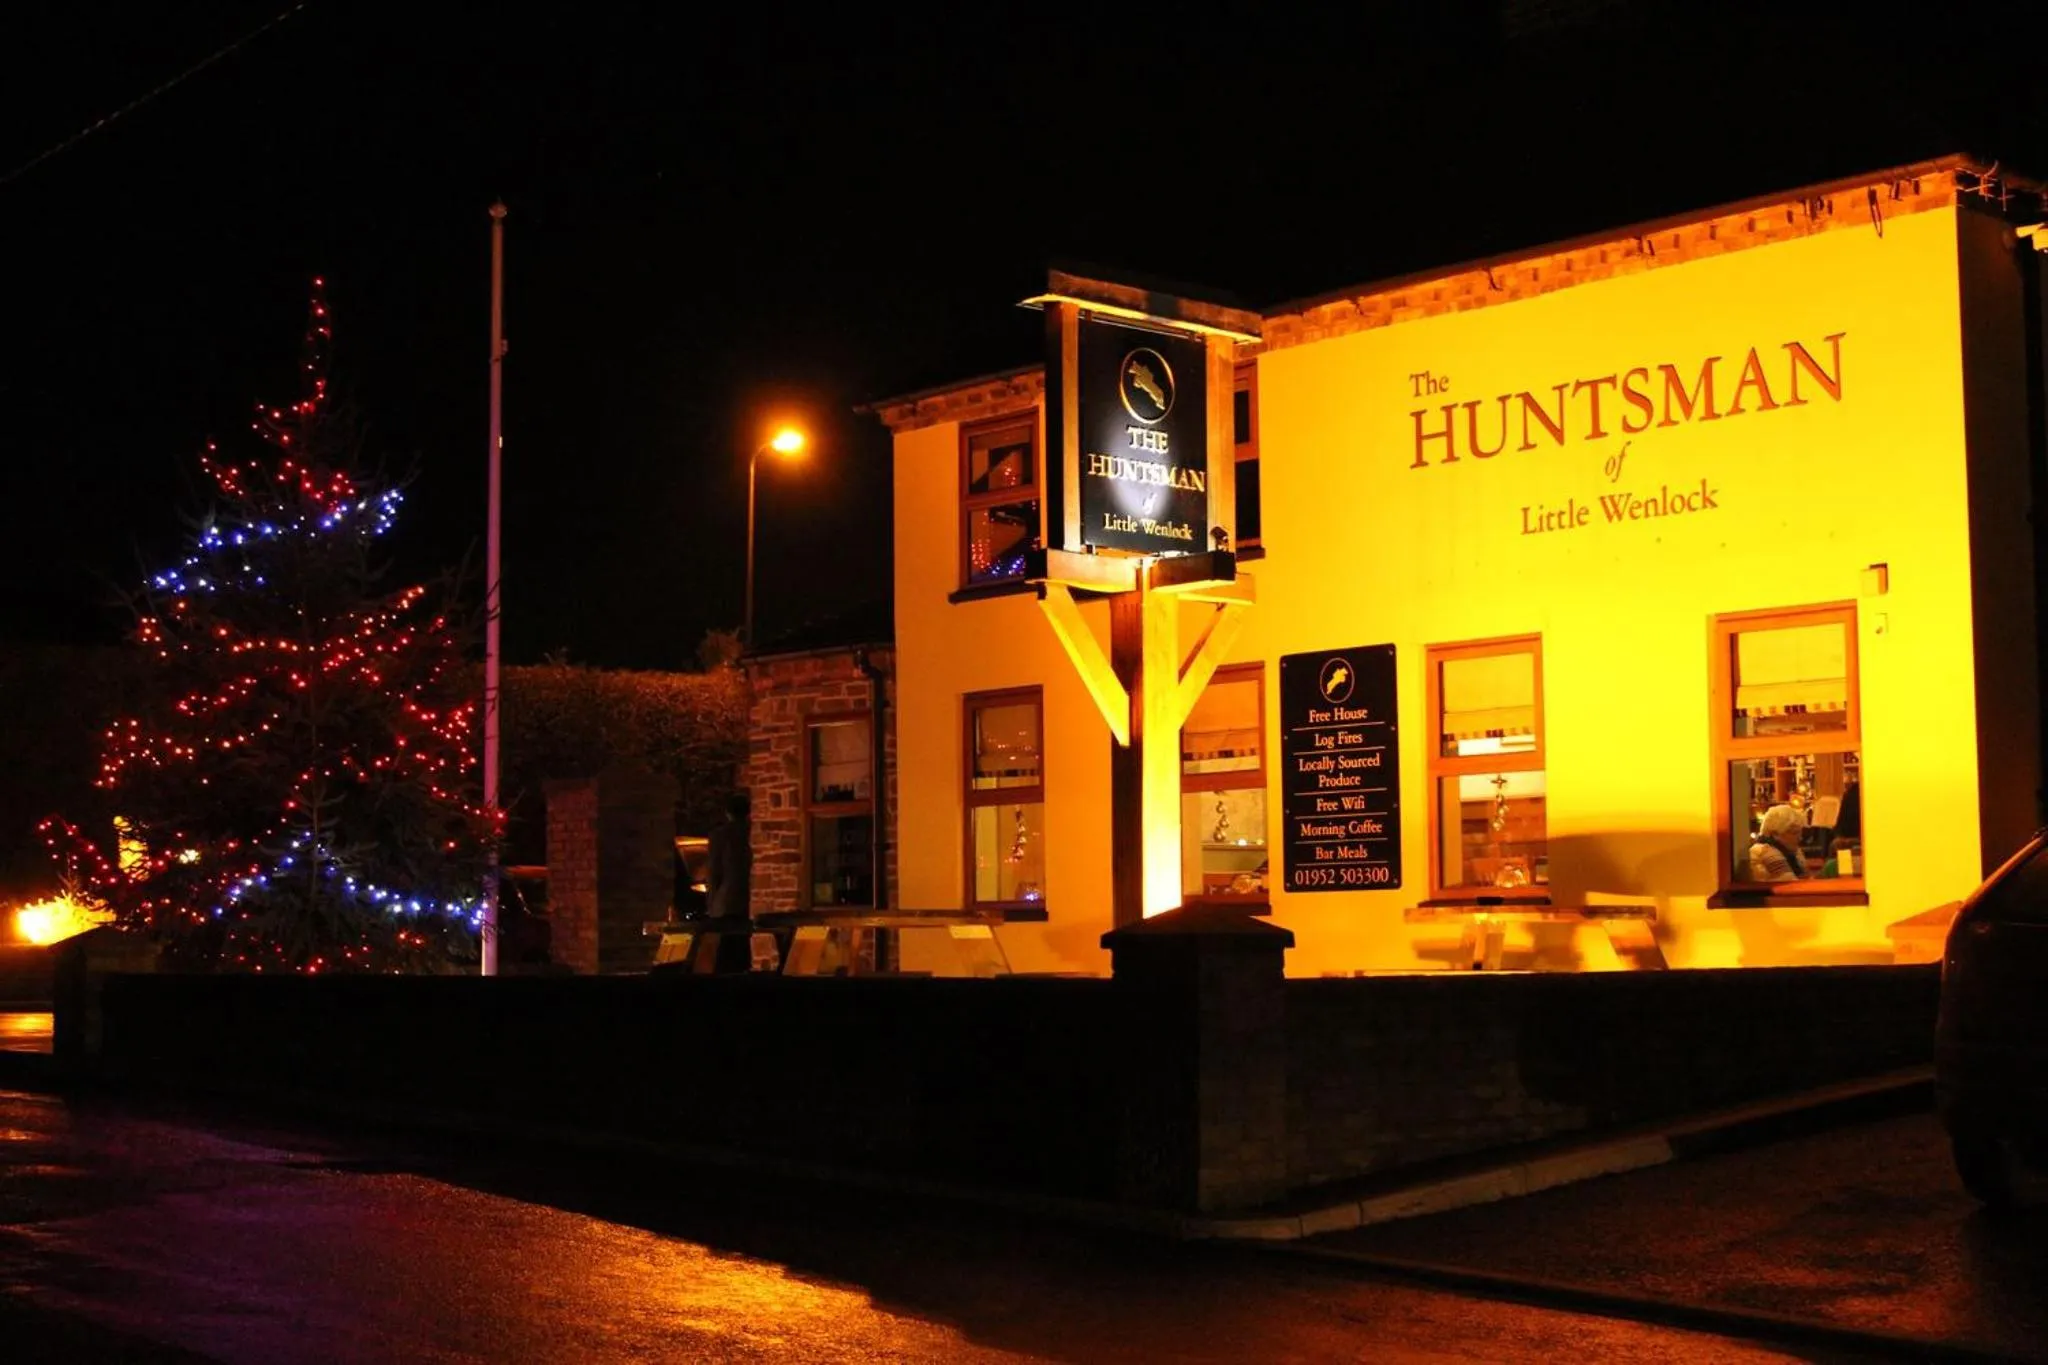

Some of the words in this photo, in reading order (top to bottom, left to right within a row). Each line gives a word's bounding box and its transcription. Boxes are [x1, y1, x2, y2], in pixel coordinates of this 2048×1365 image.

[1410, 370, 1449, 397] The
[1408, 332, 1847, 469] HUNTSMAN
[1127, 426, 1169, 454] THE
[1603, 441, 1632, 482] of
[1088, 453, 1206, 492] HUNTSMAN
[1520, 498, 1589, 535] Little
[1599, 479, 1719, 524] Wenlock
[1104, 513, 1138, 534] Little
[1141, 518, 1193, 540] Wenlock
[1309, 709, 1331, 723] Free
[1334, 706, 1368, 721] House
[1314, 733, 1335, 748] Log
[1337, 731, 1363, 744] Fires
[1299, 757, 1336, 773] Locally
[1337, 754, 1380, 770] Sourced
[1318, 774, 1361, 788] Produce
[1316, 798, 1338, 811] Free
[1341, 795, 1365, 810] Wifi
[1300, 822, 1345, 838] Morning
[1348, 820, 1382, 834] Coffee
[1315, 847, 1333, 860] Bar
[1337, 845, 1368, 859] Meals
[1295, 869, 1335, 885] 01952
[1339, 867, 1389, 884] 503300
